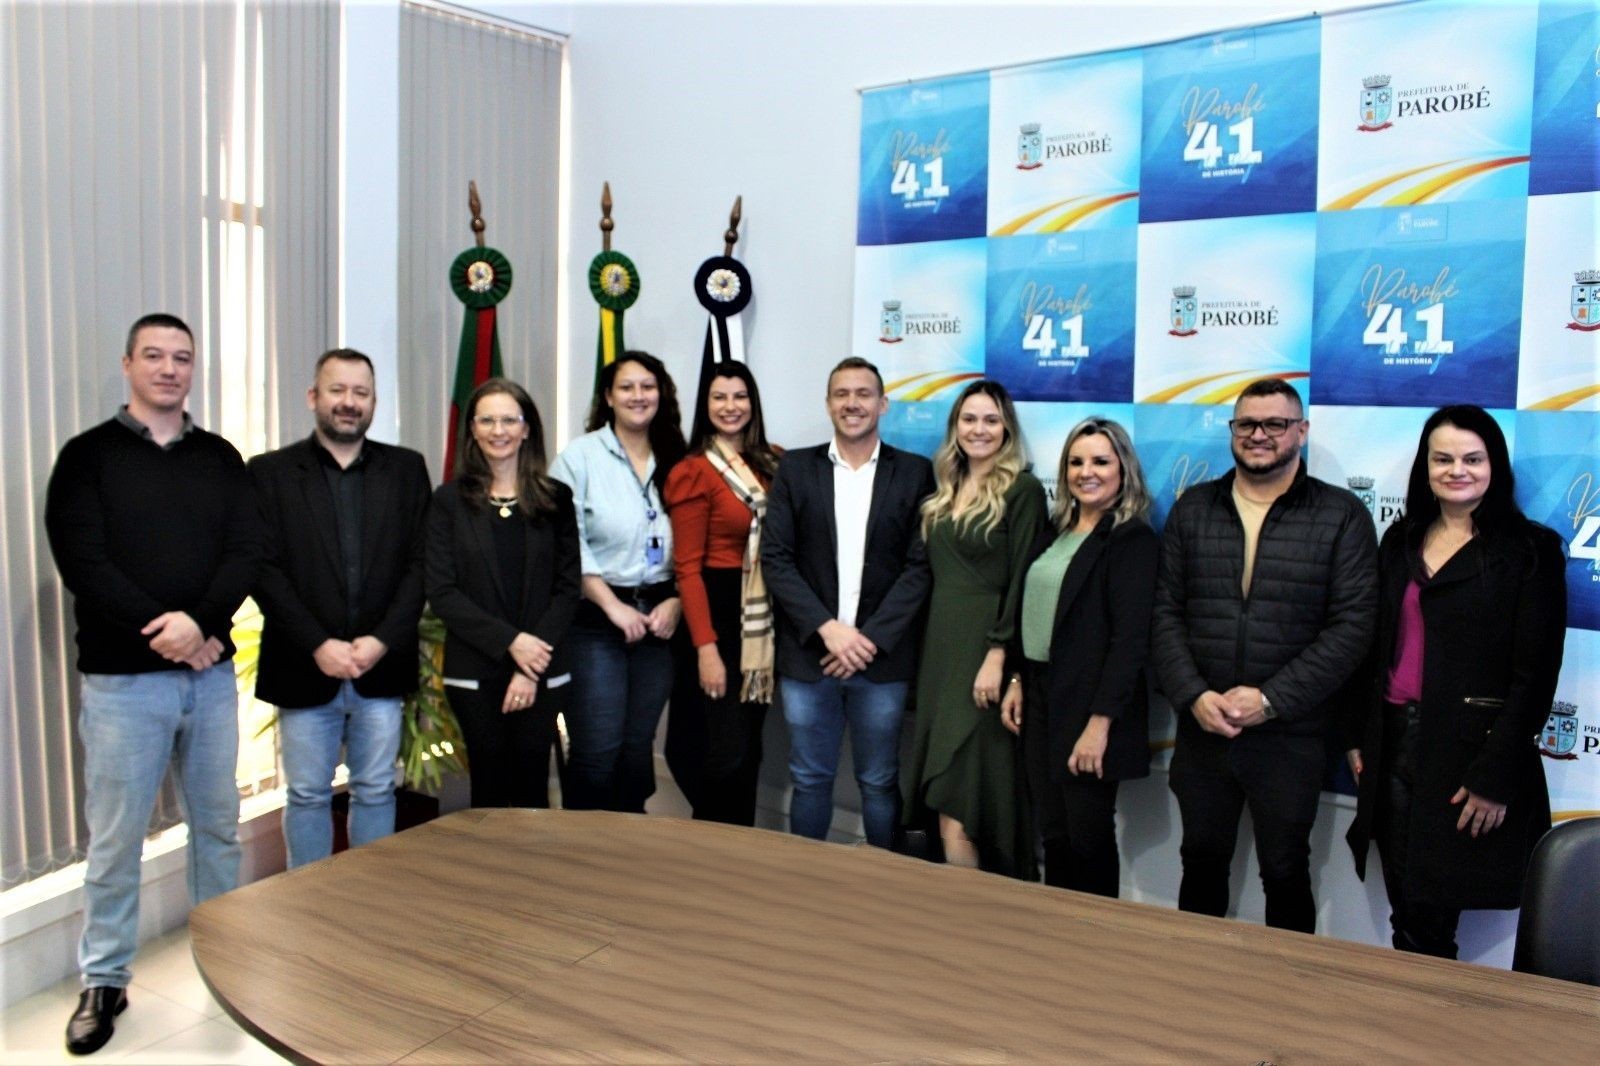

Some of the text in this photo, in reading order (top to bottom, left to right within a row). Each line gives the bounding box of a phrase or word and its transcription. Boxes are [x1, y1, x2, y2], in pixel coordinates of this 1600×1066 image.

[1397, 82, 1469, 97] PREFEITURA DE
[1397, 86, 1491, 117] PAROBÉ
[1046, 133, 1112, 159] PAROBÉ
[1183, 117, 1263, 168] 41
[891, 156, 950, 201] 41
[1361, 264, 1459, 318] Parobé
[905, 316, 962, 335] PAROBÉ
[1201, 305, 1279, 326] PAROBÉ
[1363, 303, 1454, 355] 41
[1022, 314, 1090, 358] 41
